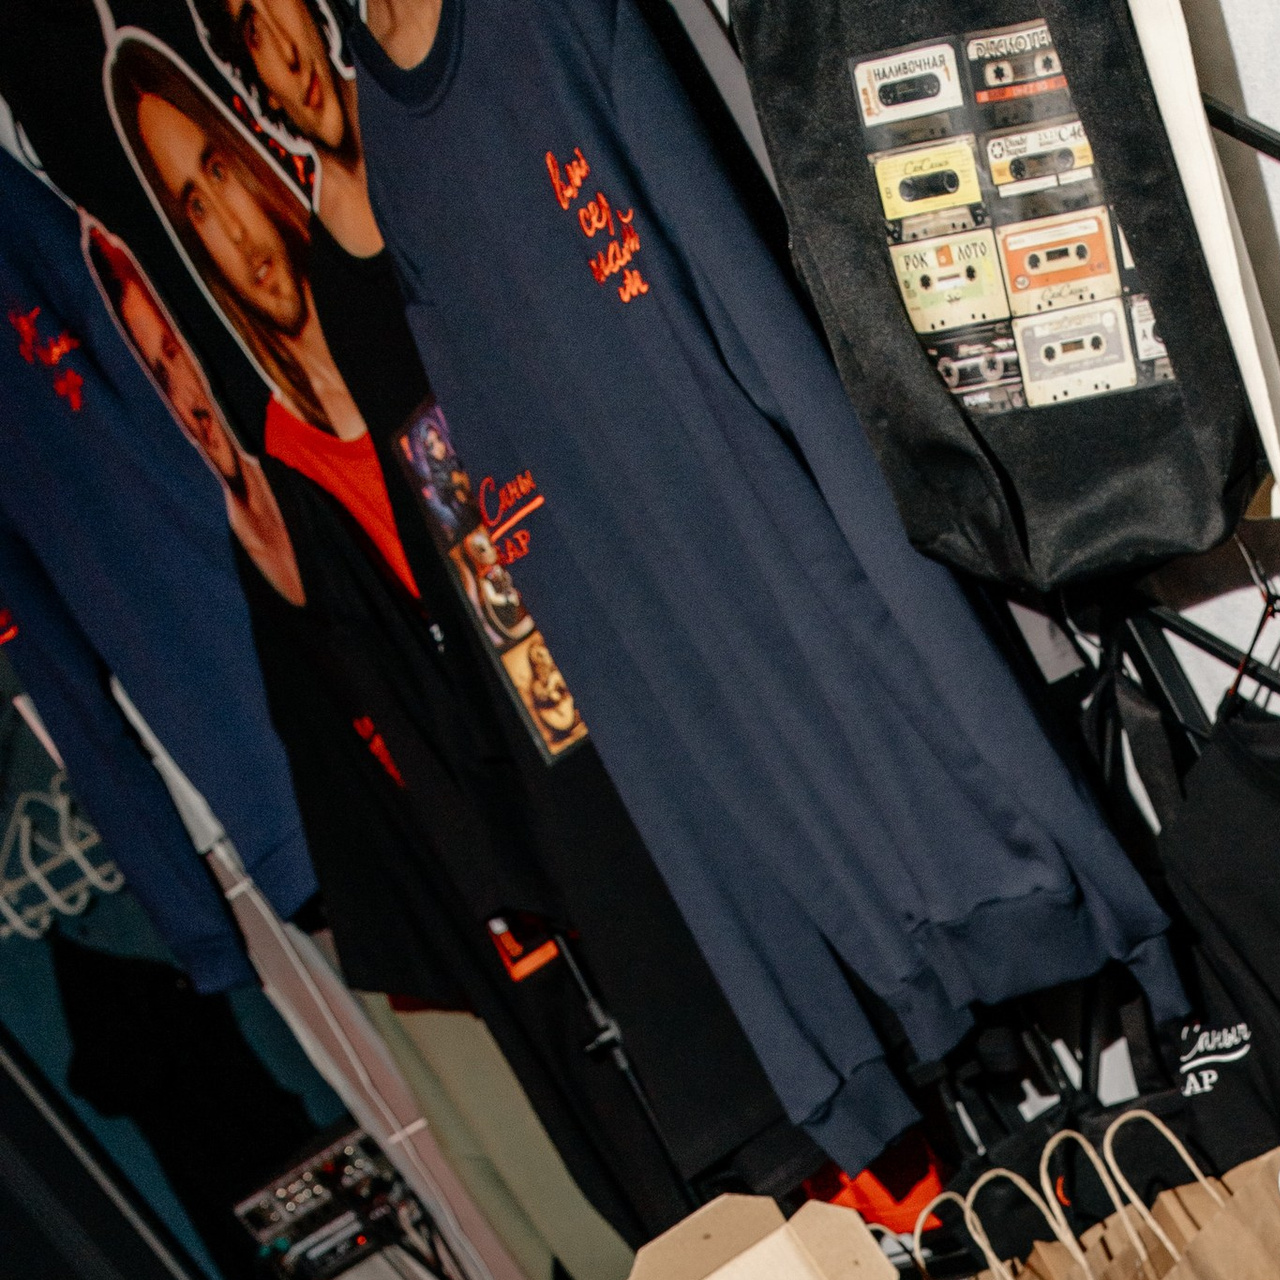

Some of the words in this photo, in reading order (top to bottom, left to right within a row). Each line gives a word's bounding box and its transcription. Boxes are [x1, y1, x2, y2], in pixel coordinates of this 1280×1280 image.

[872, 54, 947, 80] НАЛИВОЧНАЯ
[497, 529, 531, 565] АР
[1181, 1069, 1219, 1097] АР
